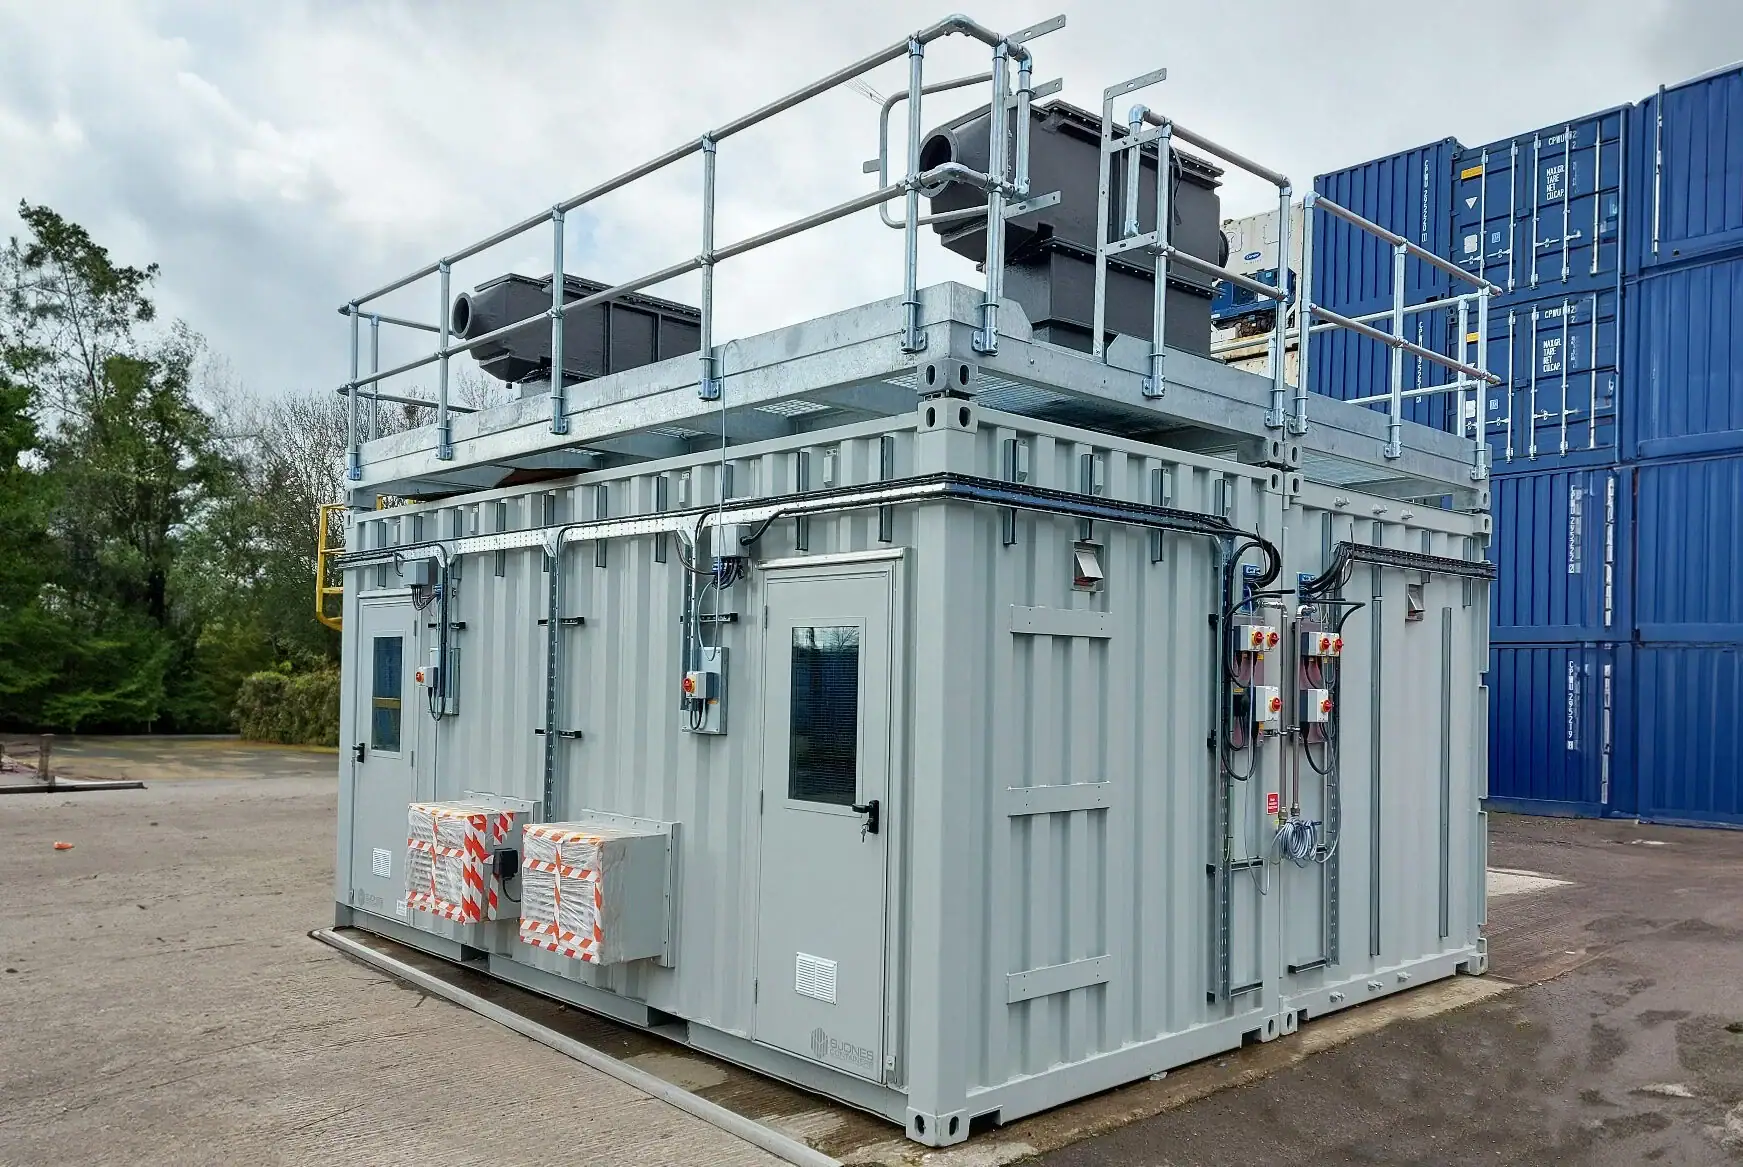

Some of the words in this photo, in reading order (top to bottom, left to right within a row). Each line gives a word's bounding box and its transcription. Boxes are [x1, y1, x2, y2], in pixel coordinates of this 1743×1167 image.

[1547, 174, 1560, 184] TARE
[1546, 183, 1556, 192] NET
[1543, 347, 1557, 356] TARE
[1543, 355, 1553, 364] NET
